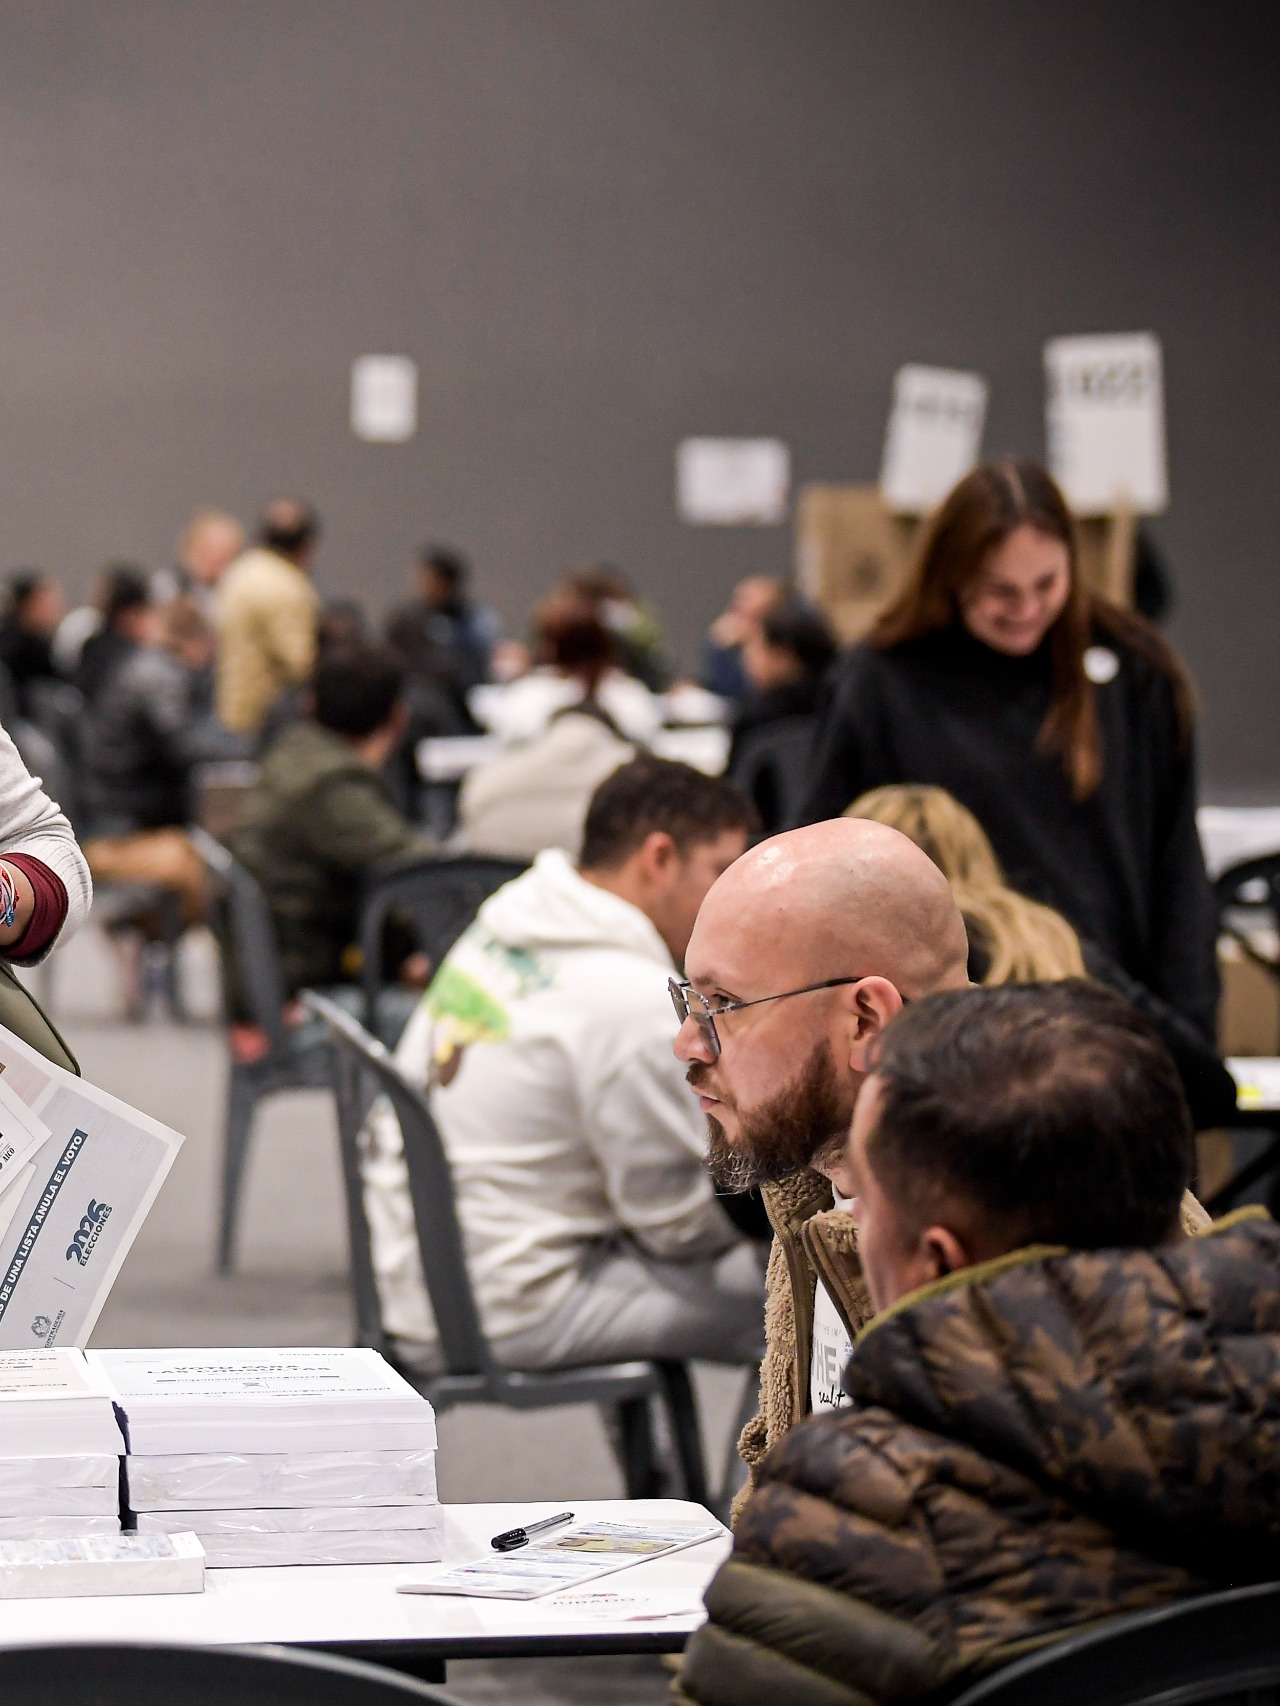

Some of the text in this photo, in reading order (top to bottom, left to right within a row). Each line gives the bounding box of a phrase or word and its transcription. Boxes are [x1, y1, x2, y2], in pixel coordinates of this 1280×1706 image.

[0, 1284, 12, 1301] DE
[6, 1259, 24, 1283] UNA
[18, 1225, 39, 1257] LISTA
[34, 1185, 58, 1223] ANULA
[53, 1169, 66, 1182] EL
[61, 1134, 83, 1164] VOTO
[64, 1196, 107, 1262] 2026
[78, 1205, 113, 1266] ELECCIONES
